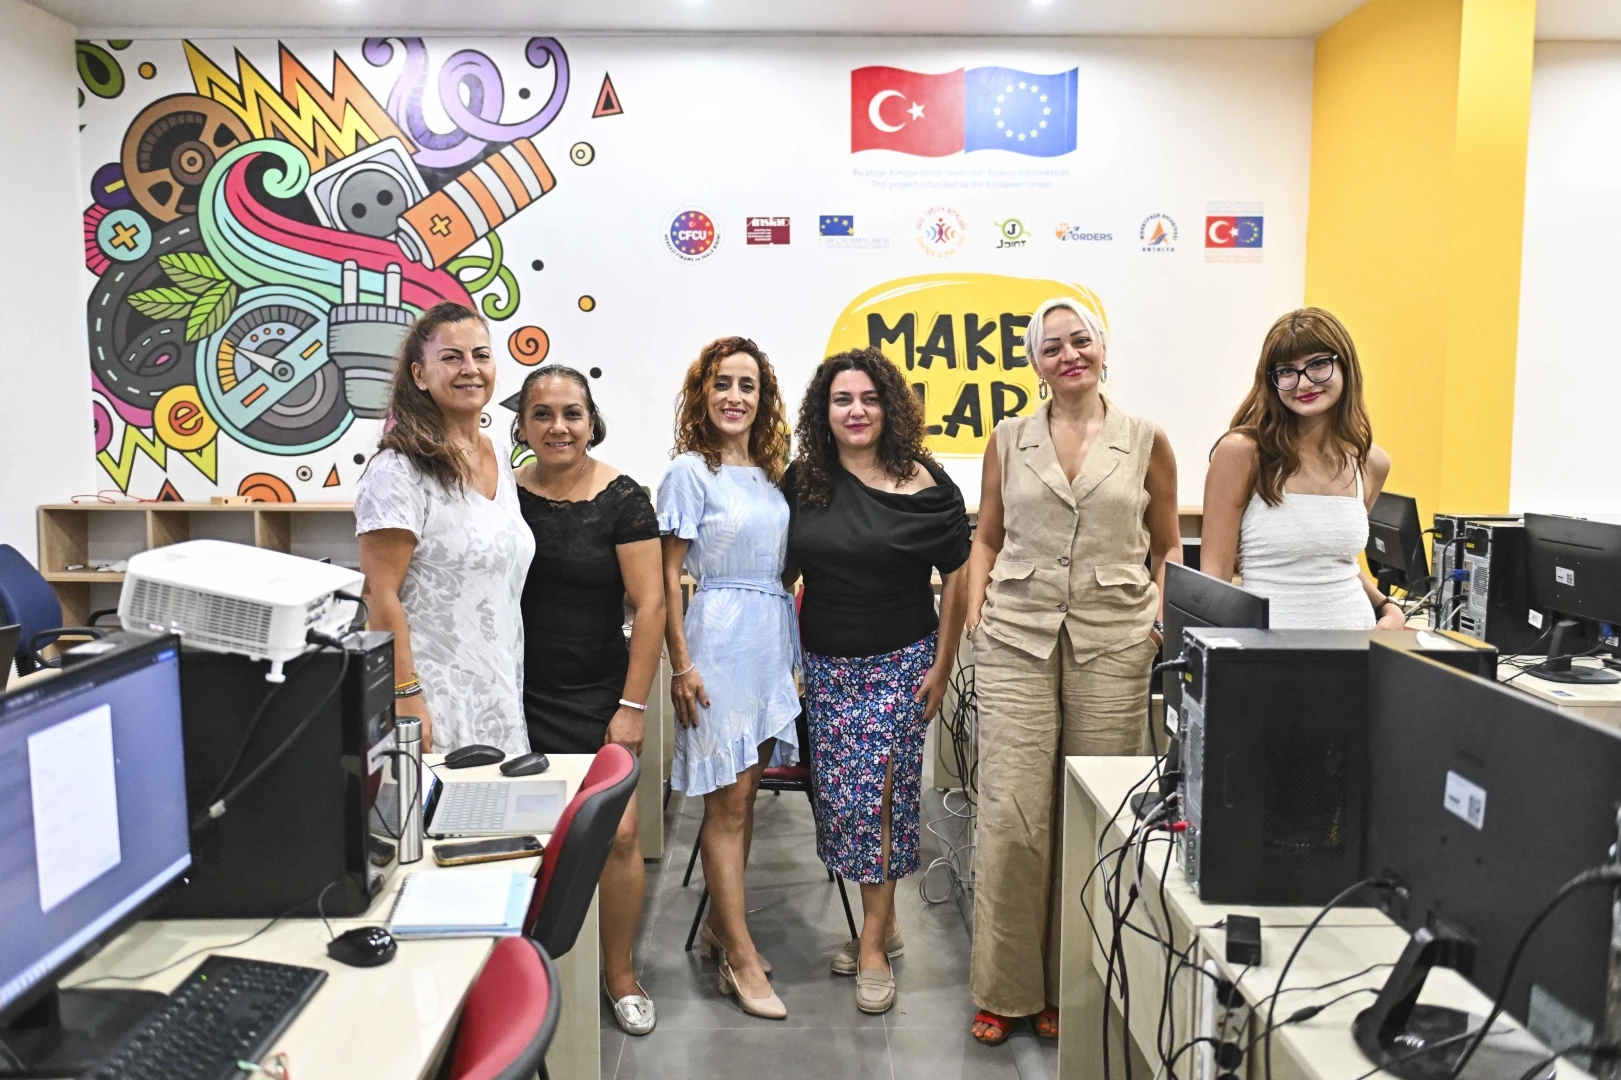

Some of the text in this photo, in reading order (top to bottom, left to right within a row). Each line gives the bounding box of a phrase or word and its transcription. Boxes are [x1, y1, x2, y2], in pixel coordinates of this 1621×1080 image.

[889, 180, 918, 190] project
[928, 180, 957, 188] funded
[971, 180, 984, 188] the
[986, 180, 1025, 190] European
[678, 230, 707, 241] CFCU
